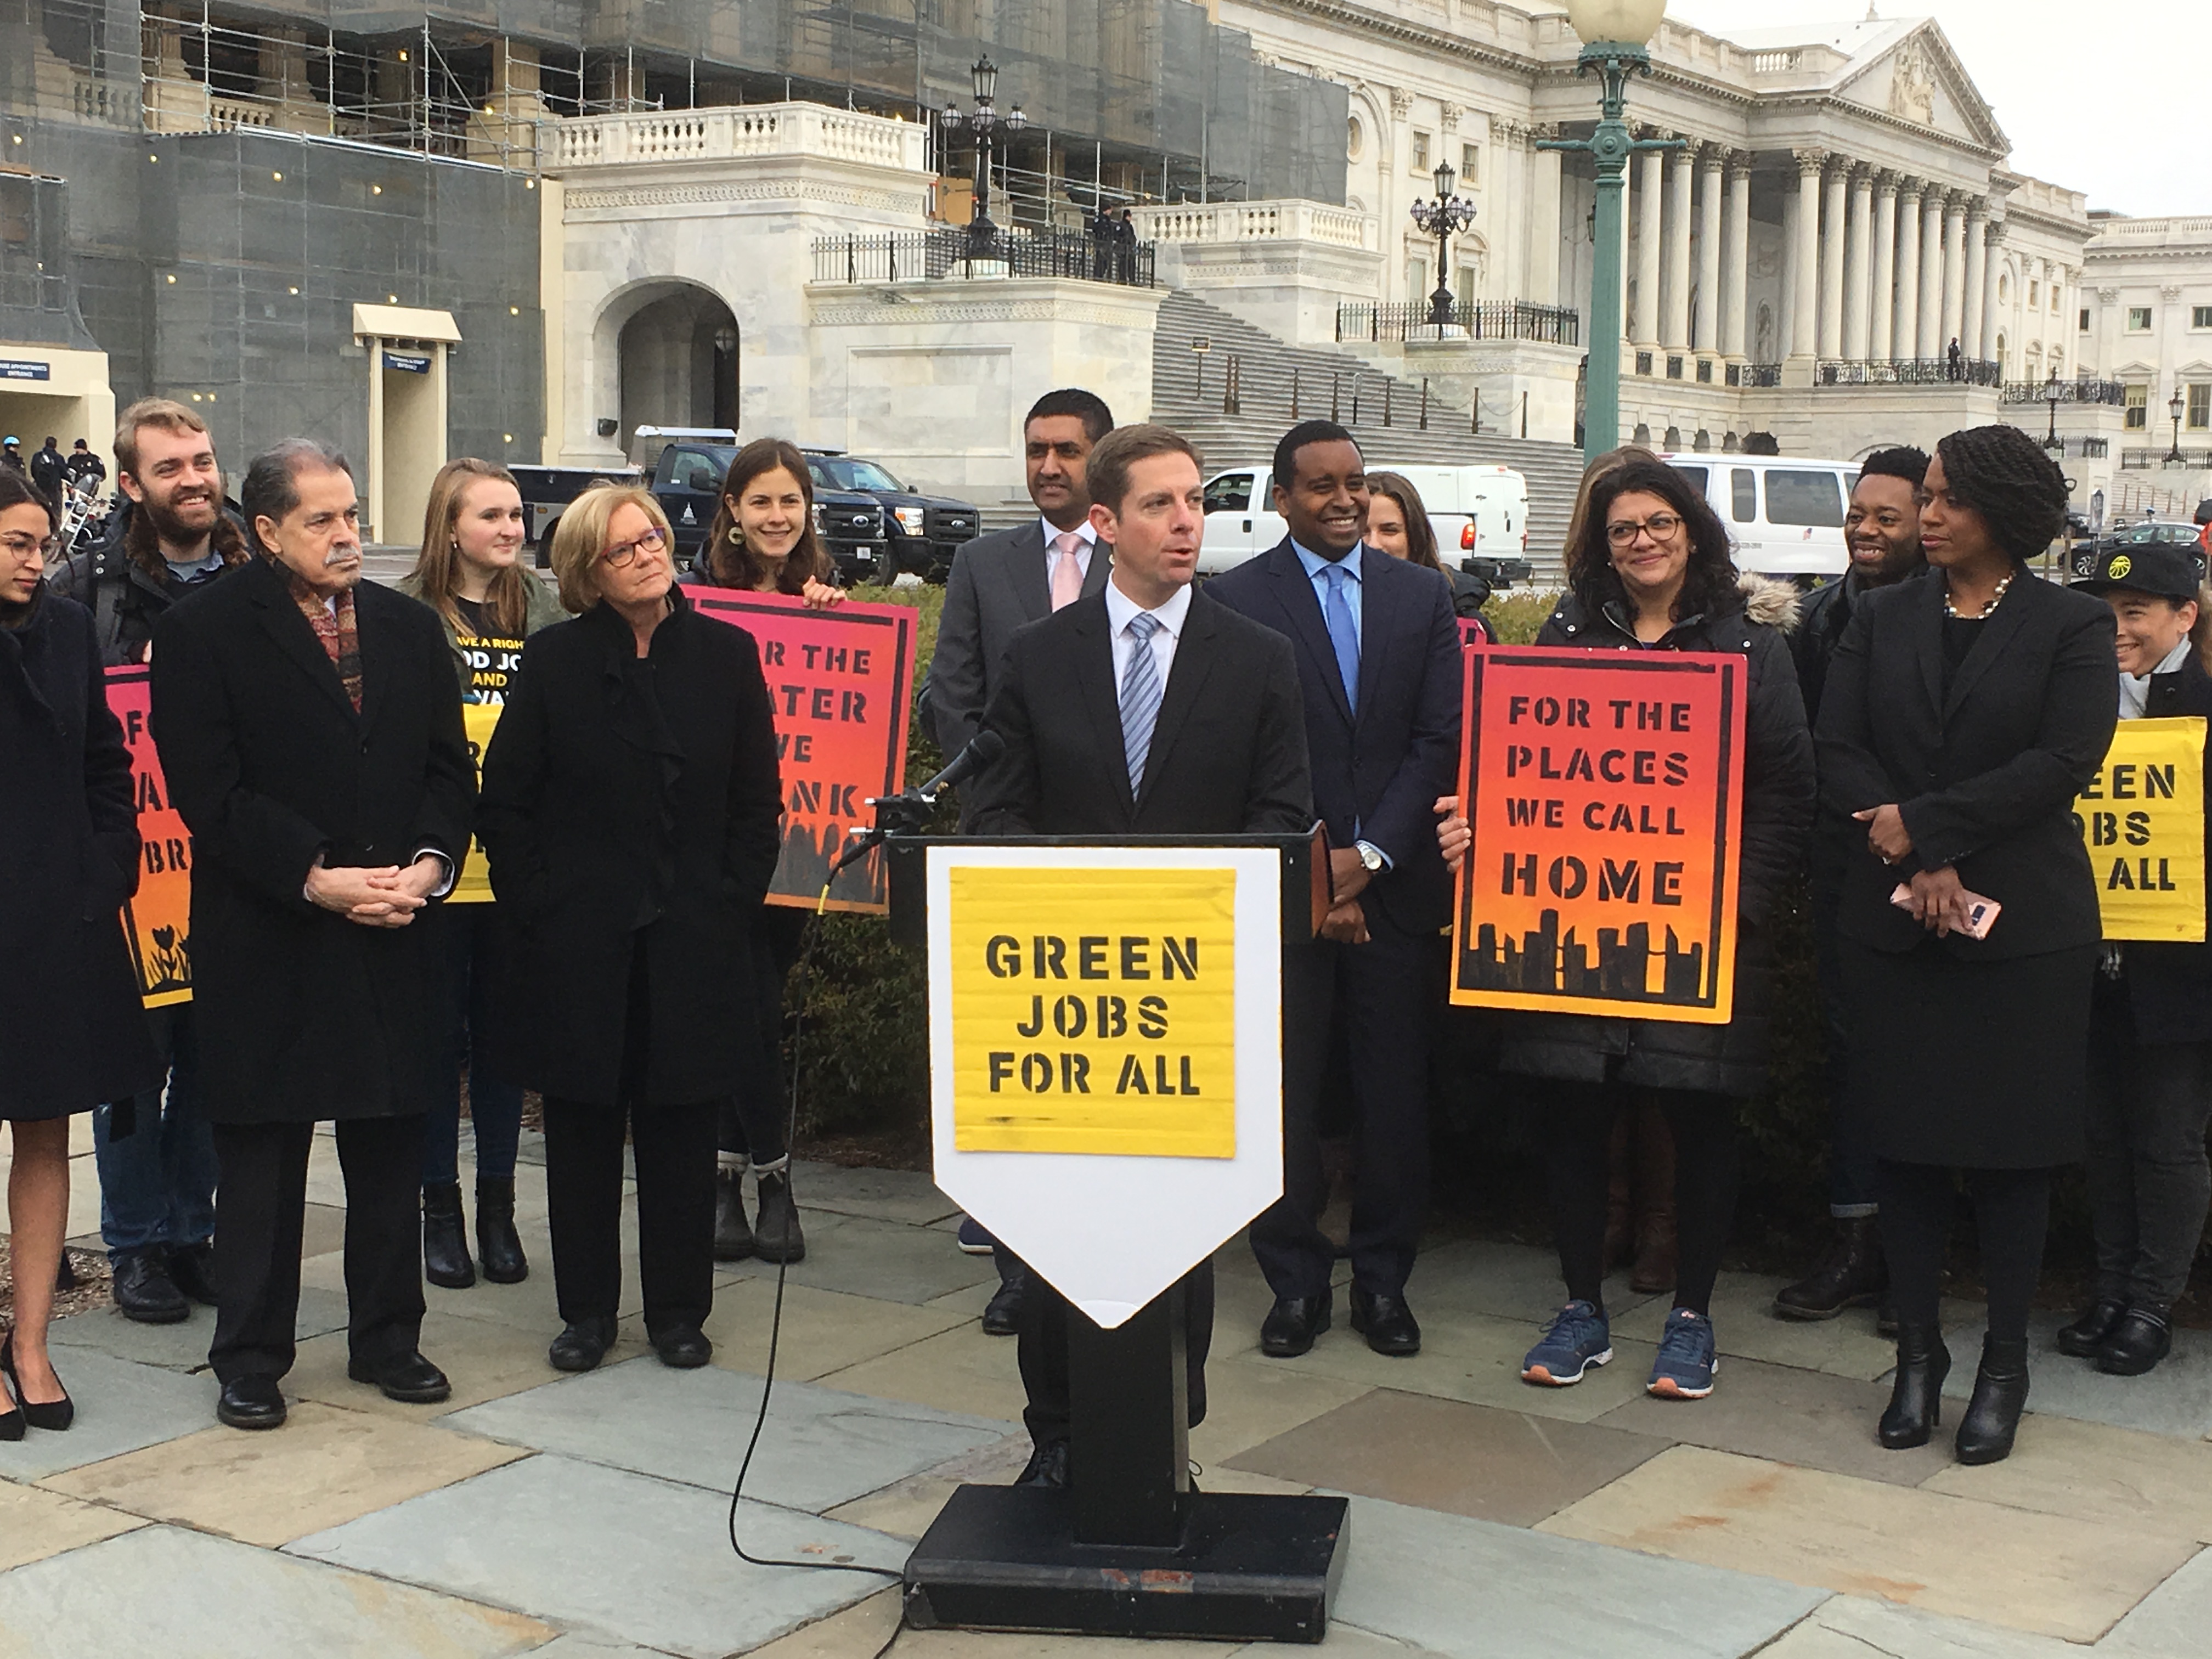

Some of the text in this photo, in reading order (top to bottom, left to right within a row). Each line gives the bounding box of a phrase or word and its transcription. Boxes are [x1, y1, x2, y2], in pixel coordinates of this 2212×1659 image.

[492, 639, 524, 650] RIGH
[802, 645, 871, 675] THE
[472, 672, 507, 687] AND
[1509, 696, 1690, 732] FOR THE
[1507, 745, 1689, 786] PLACES
[792, 780, 859, 817] NK
[1506, 798, 1685, 835] WE CALL
[1501, 852, 1684, 906] HOME
[2107, 857, 2176, 890] ALL
[986, 935, 1198, 980] GREEN
[1017, 995, 1169, 1039] JOBS
[989, 1052, 1200, 1096] FOR ALL
